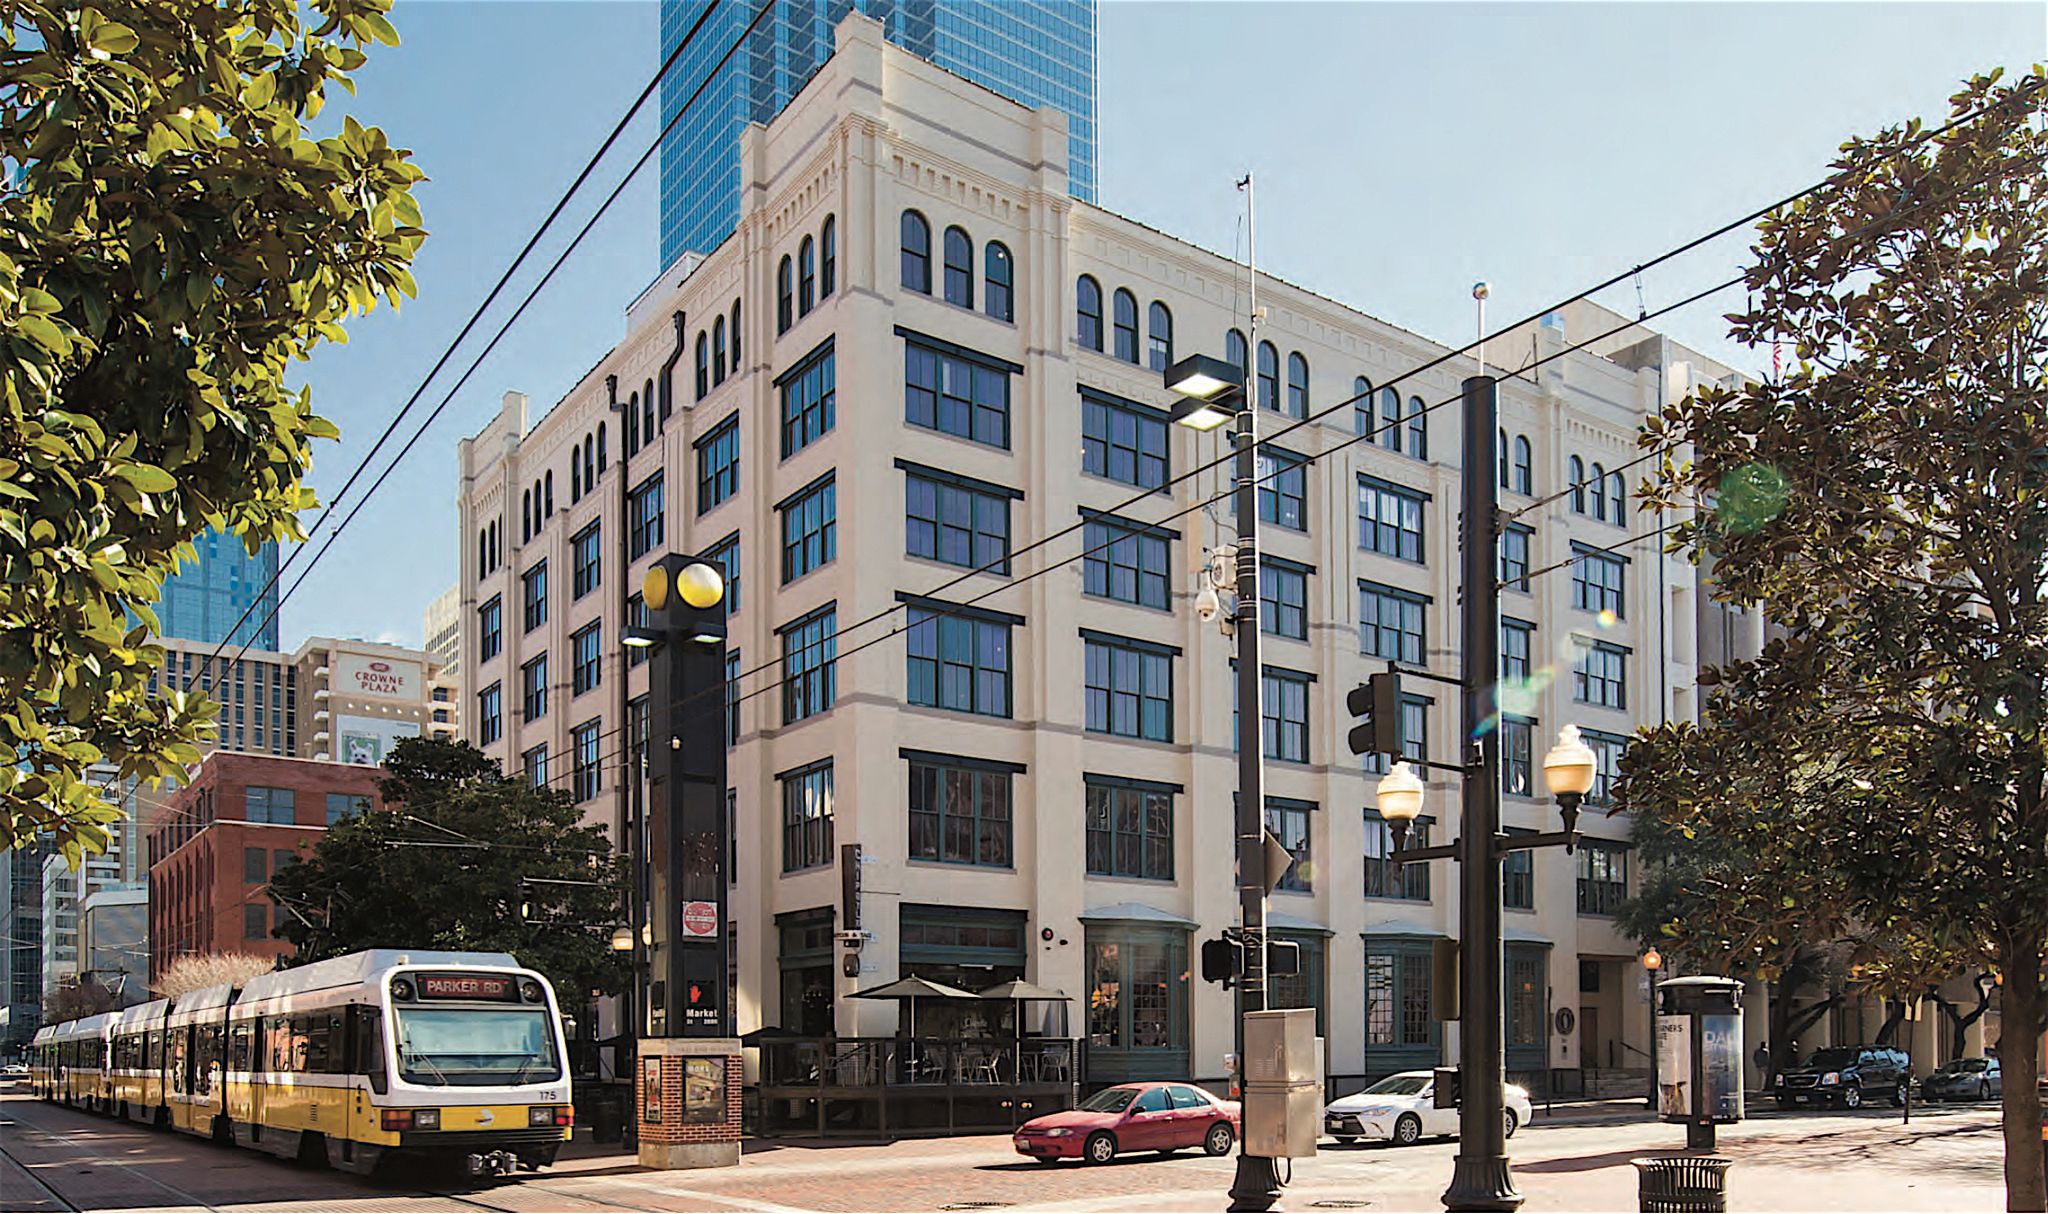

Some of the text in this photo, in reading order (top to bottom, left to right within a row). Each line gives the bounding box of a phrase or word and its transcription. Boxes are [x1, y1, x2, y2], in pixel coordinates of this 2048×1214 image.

[355, 672, 404, 685] CROWNE
[361, 681, 398, 694] PLAZA
[427, 980, 502, 993] PARKER RD
[686, 1008, 718, 1018] Market
[540, 1091, 556, 1100] 175
